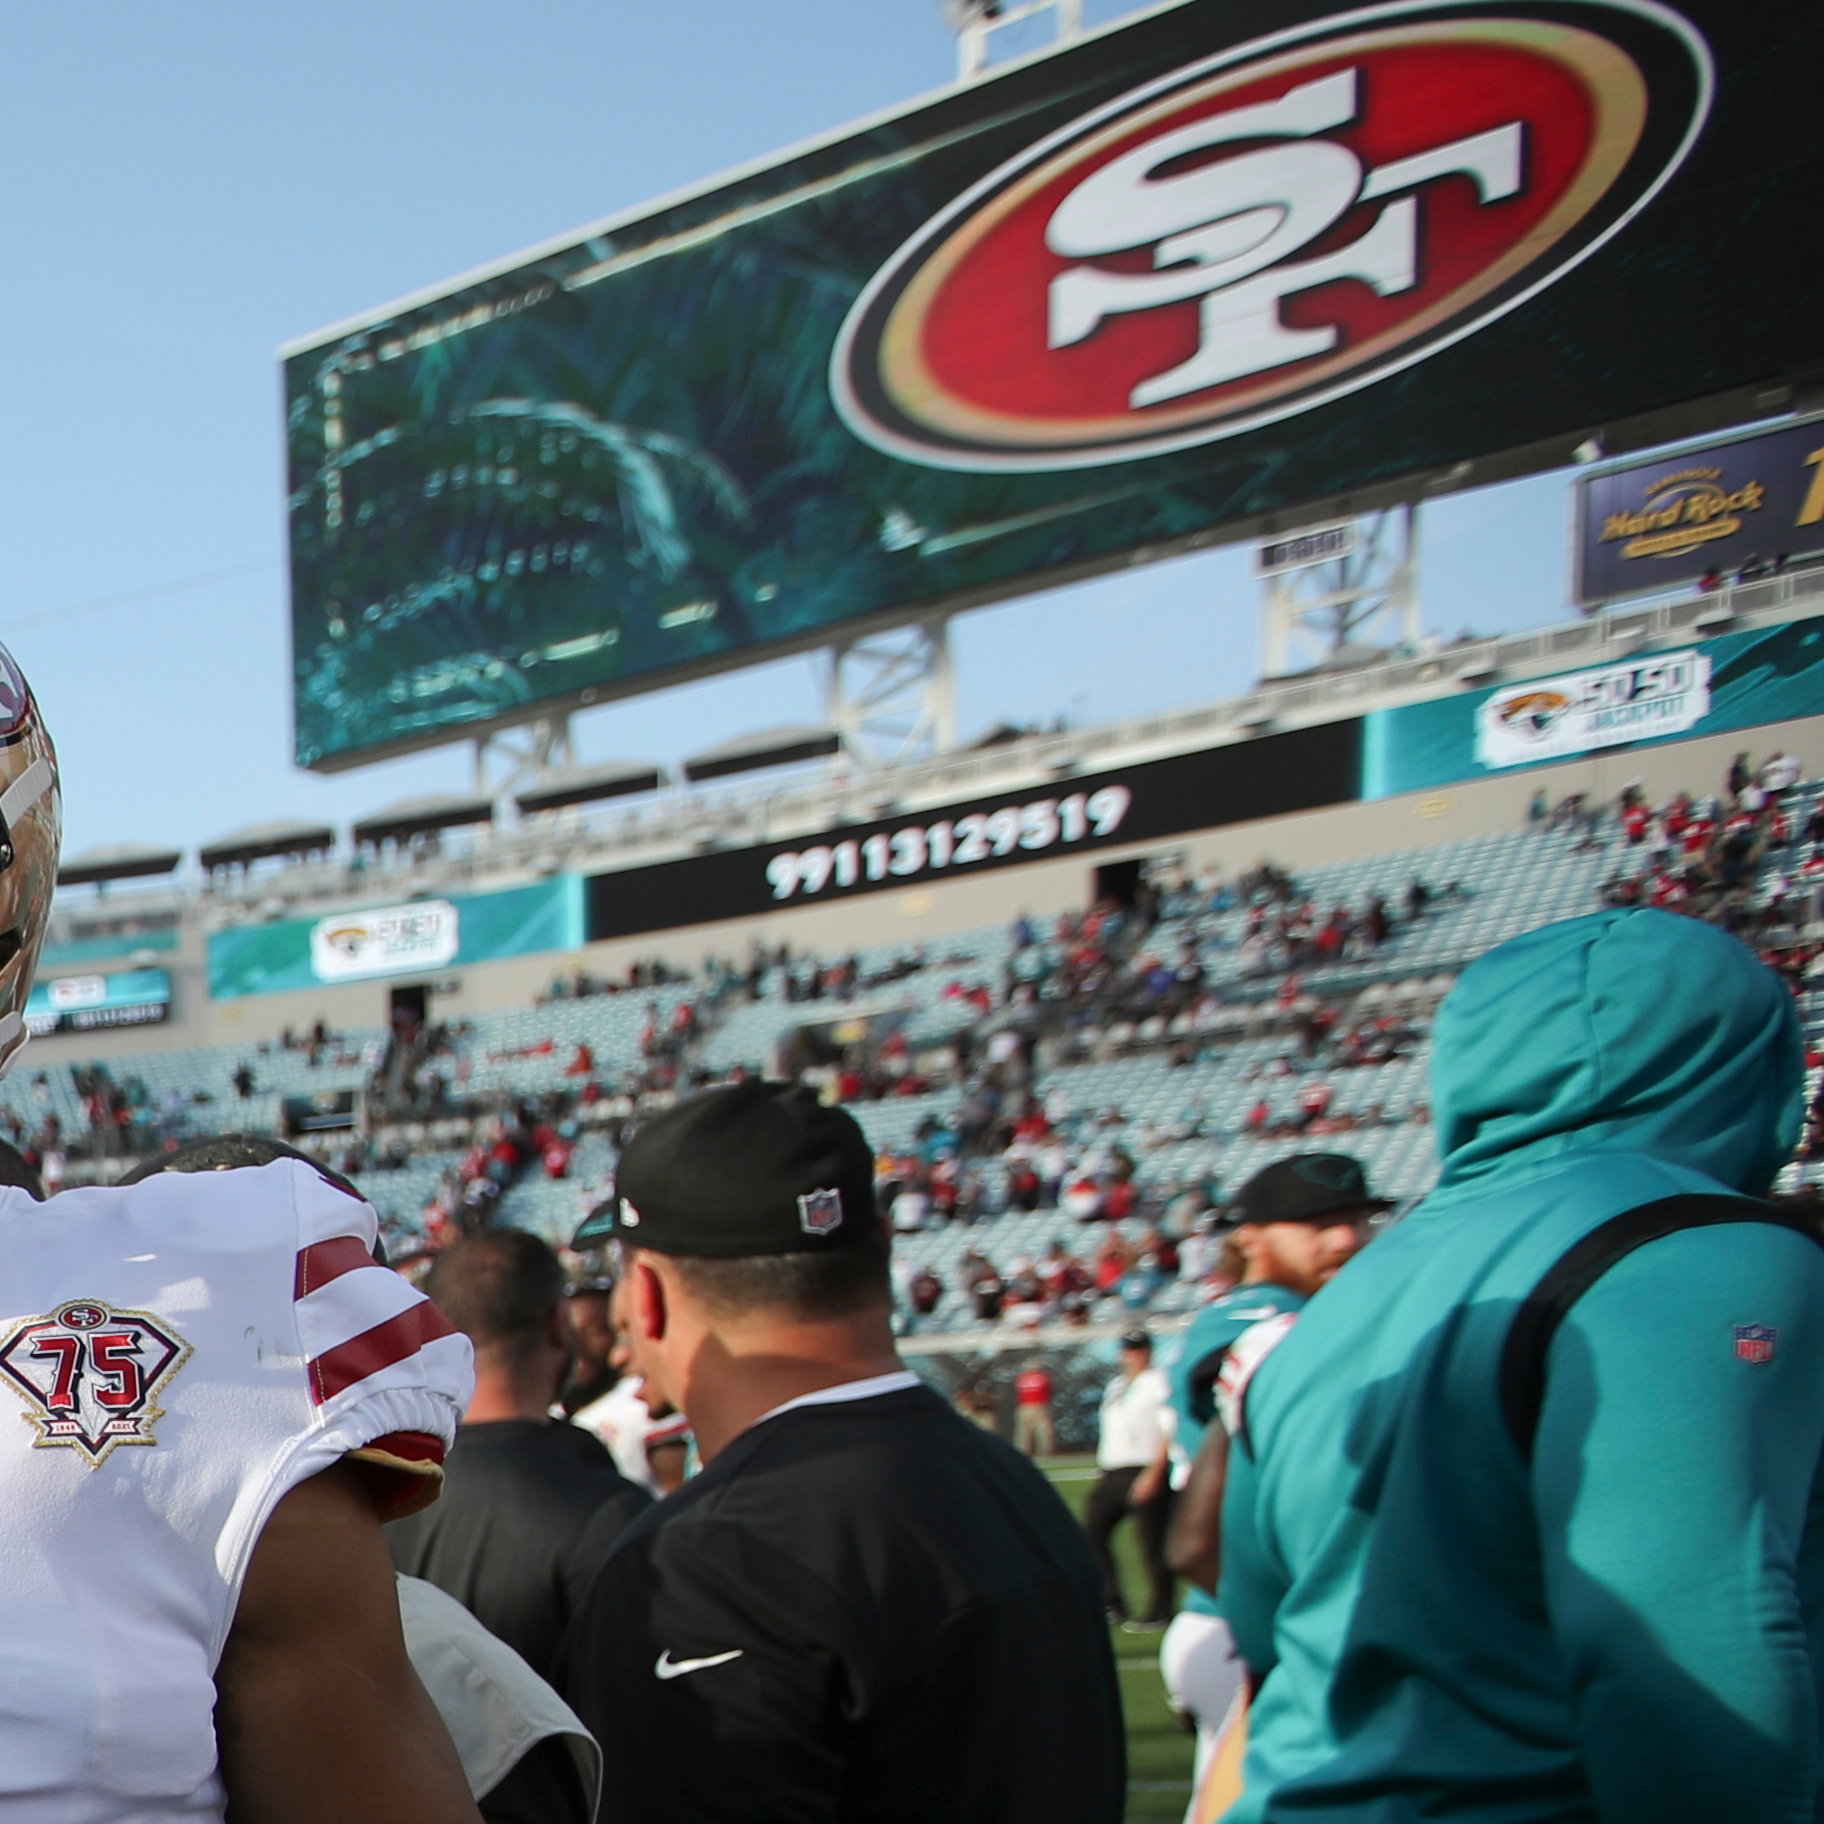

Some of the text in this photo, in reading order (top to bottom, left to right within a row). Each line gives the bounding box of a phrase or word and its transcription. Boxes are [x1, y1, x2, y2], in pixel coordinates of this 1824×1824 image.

[1600, 500, 1684, 541] Hard
[1685, 480, 1764, 522] Rock
[764, 784, 1132, 900] 99113129519
[29, 1328, 145, 1414] 75
[1737, 1340, 1771, 1361] NFL
